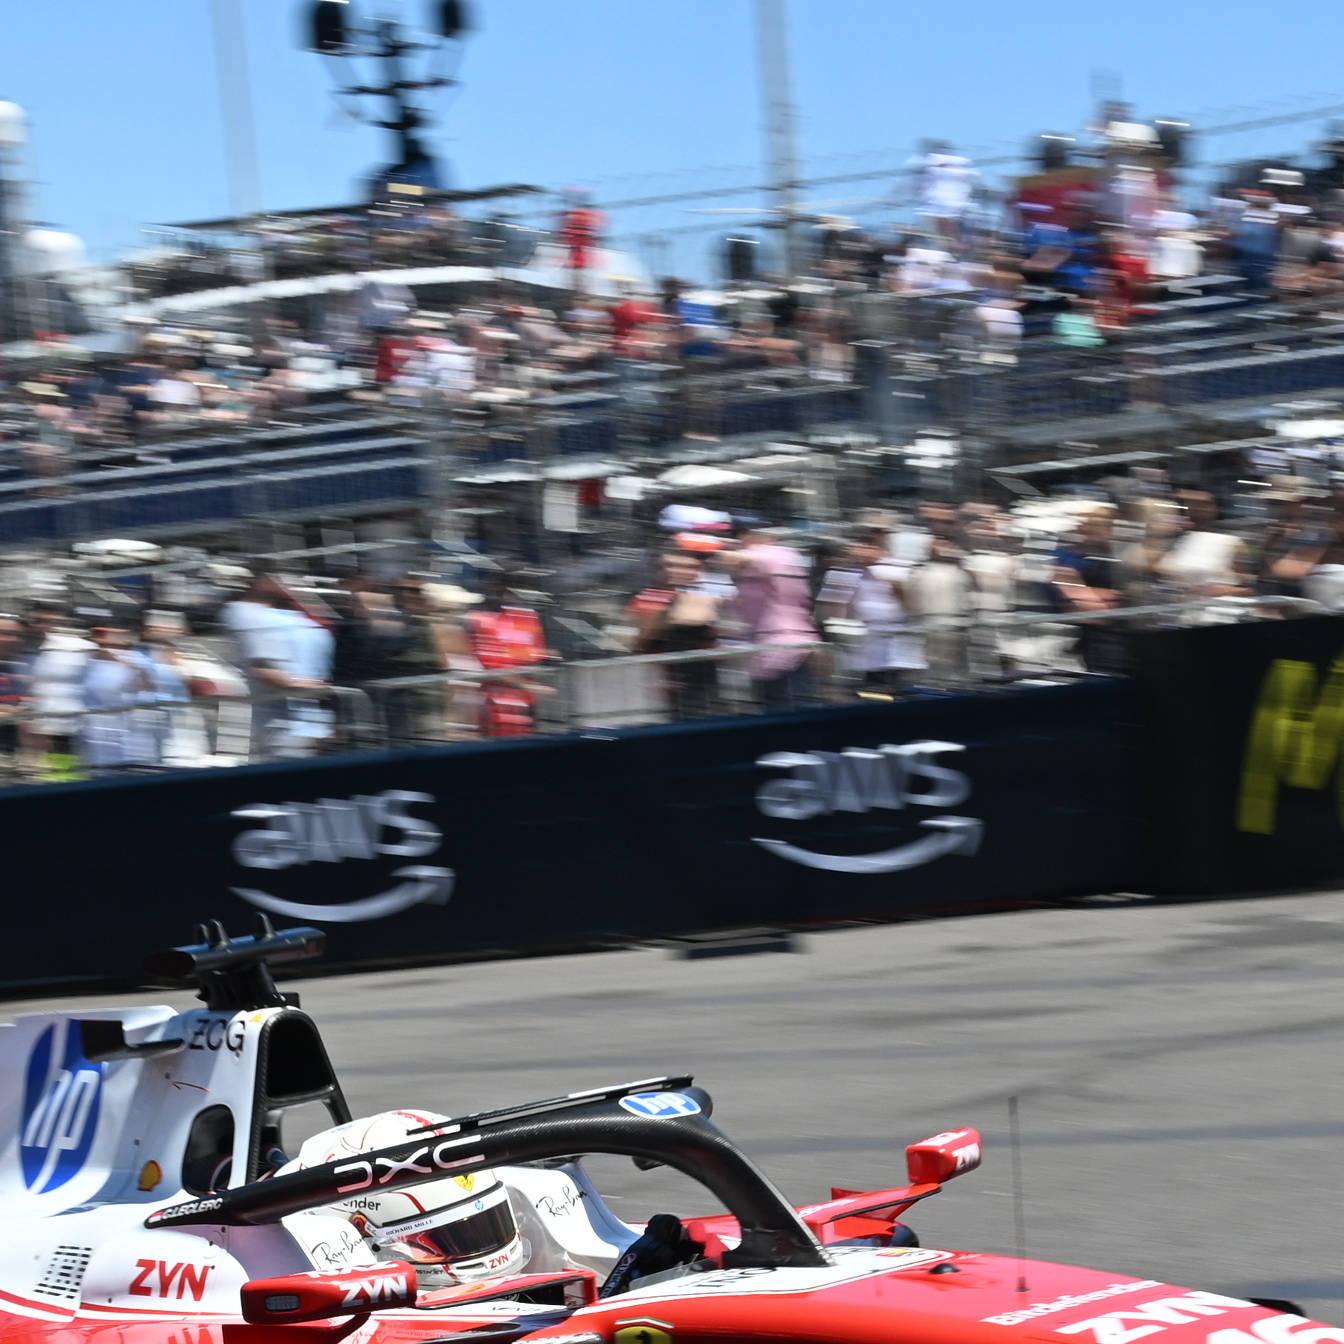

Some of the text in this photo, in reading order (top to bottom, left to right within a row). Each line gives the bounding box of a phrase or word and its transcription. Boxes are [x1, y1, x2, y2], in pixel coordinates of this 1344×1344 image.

[755, 740, 971, 820] aws
[231, 790, 443, 869] aws
[334, 1134, 485, 1194] DXC
[535, 1186, 588, 1217] Ray-Ban
[312, 1231, 368, 1266] Ray-Ban
[488, 1253, 509, 1269] ZYN
[129, 1258, 212, 1302] ZYN
[339, 1274, 408, 1308] ZYN
[979, 1280, 1165, 1326] Bitdefender
